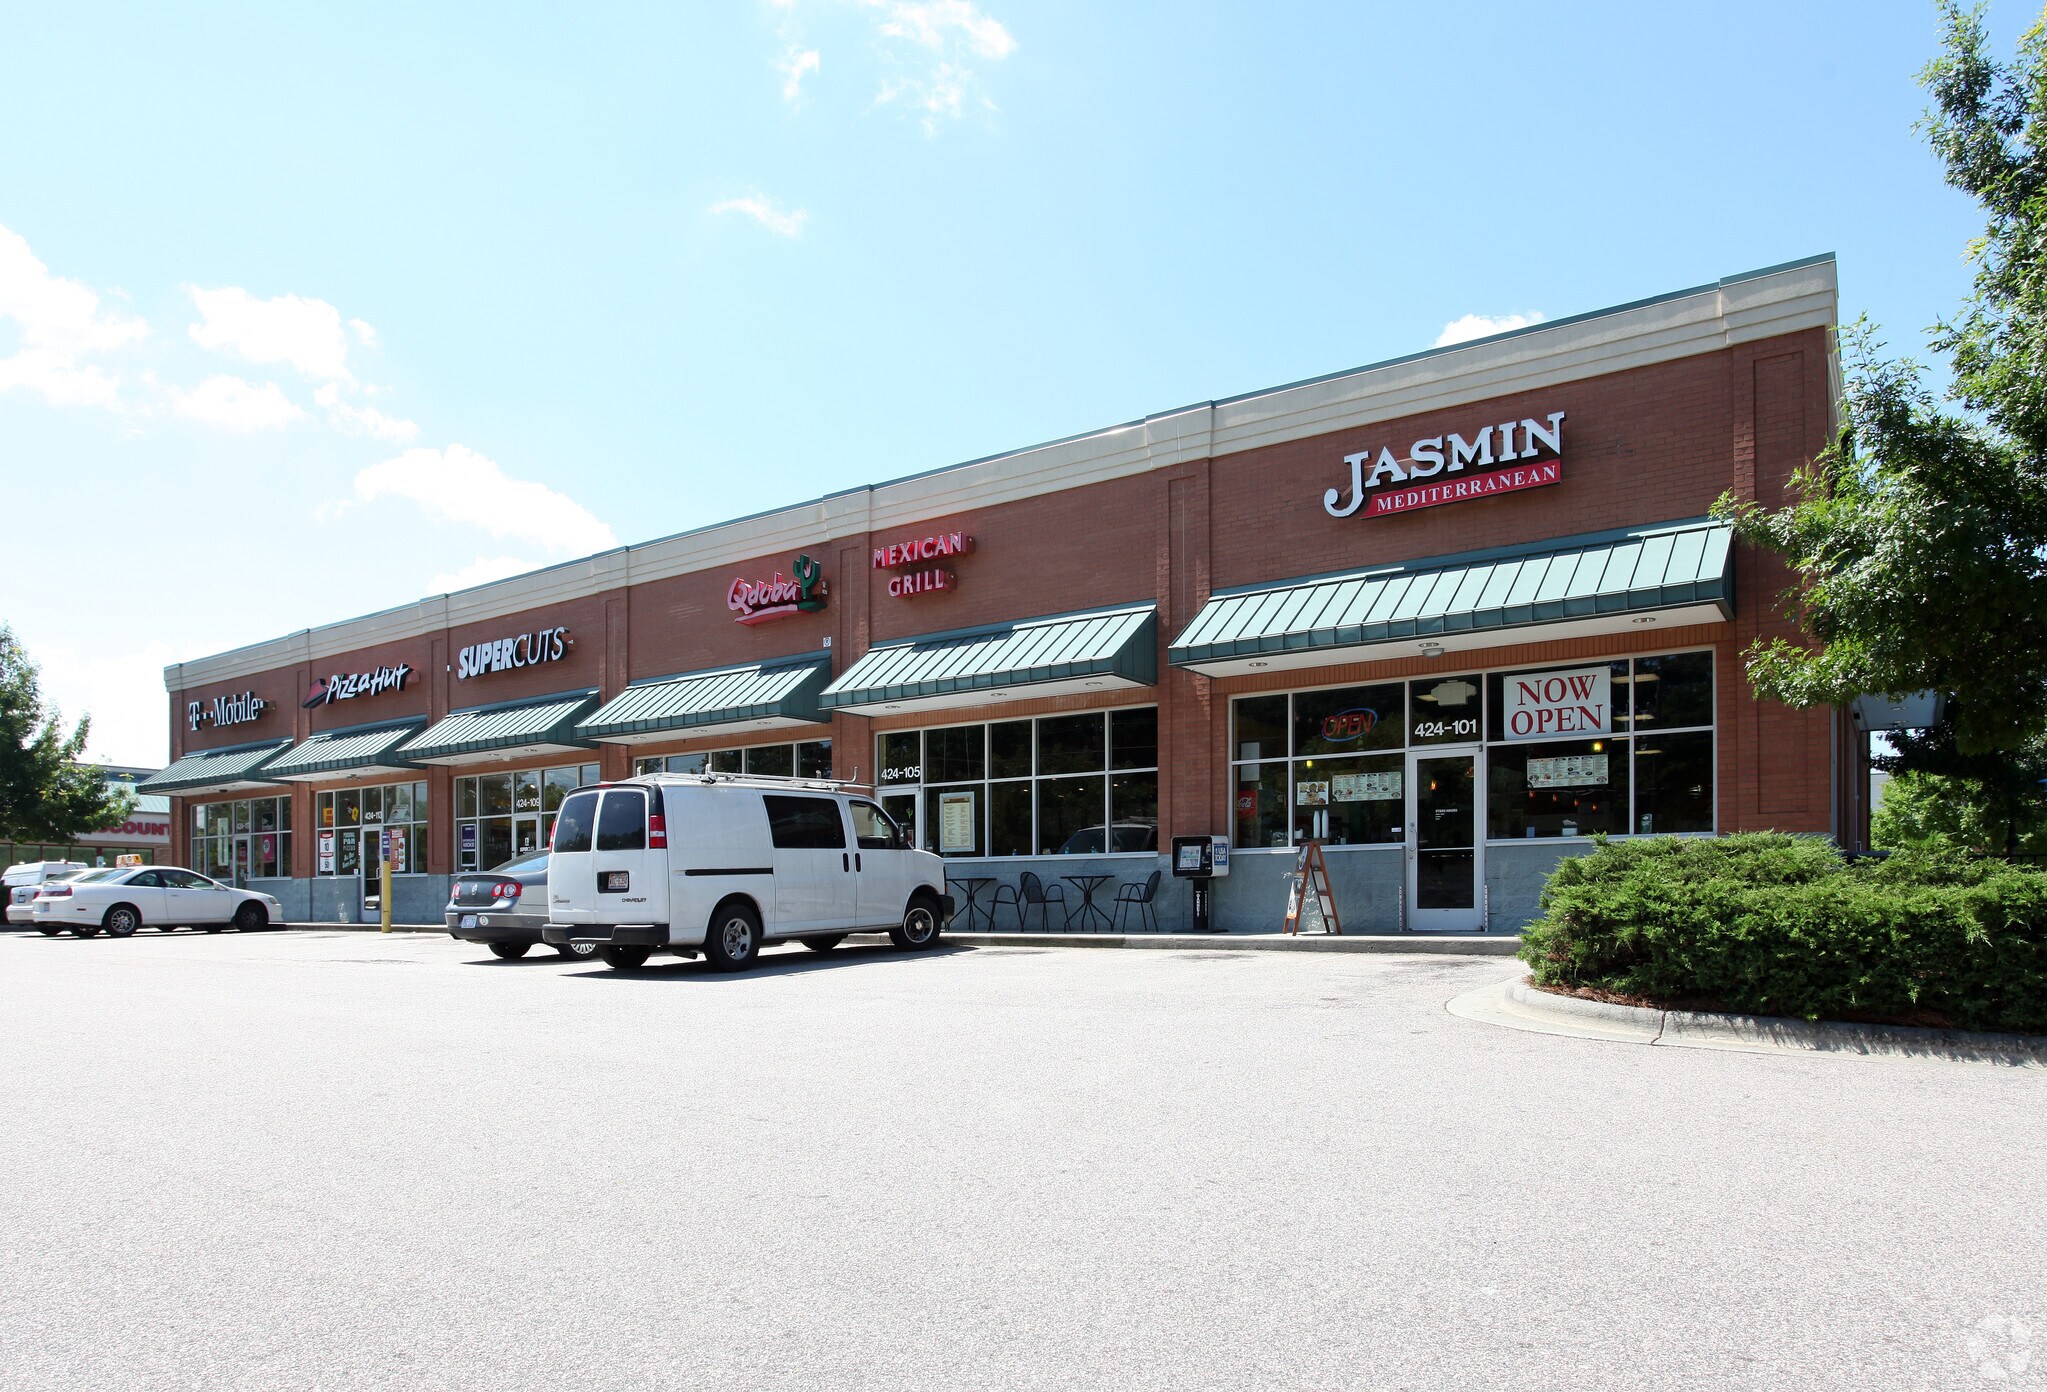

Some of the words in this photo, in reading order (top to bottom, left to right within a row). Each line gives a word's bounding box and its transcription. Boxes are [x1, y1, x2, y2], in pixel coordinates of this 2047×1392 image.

[1323, 411, 1566, 517] JASMIN
[1376, 465, 1556, 512] MEDITERRANEAN
[872, 531, 964, 568] MEXICAN
[727, 571, 798, 614] Qdoba
[888, 568, 945, 597] GRILL
[458, 626, 566, 679] SUPERCUTS
[1516, 674, 1597, 706] NOW
[1322, 712, 1373, 736] OPEN
[1414, 719, 1477, 738] 424-101
[1511, 704, 1604, 735] OPEN
[881, 765, 921, 780] 424-105
[516, 797, 540, 808] 424-109
